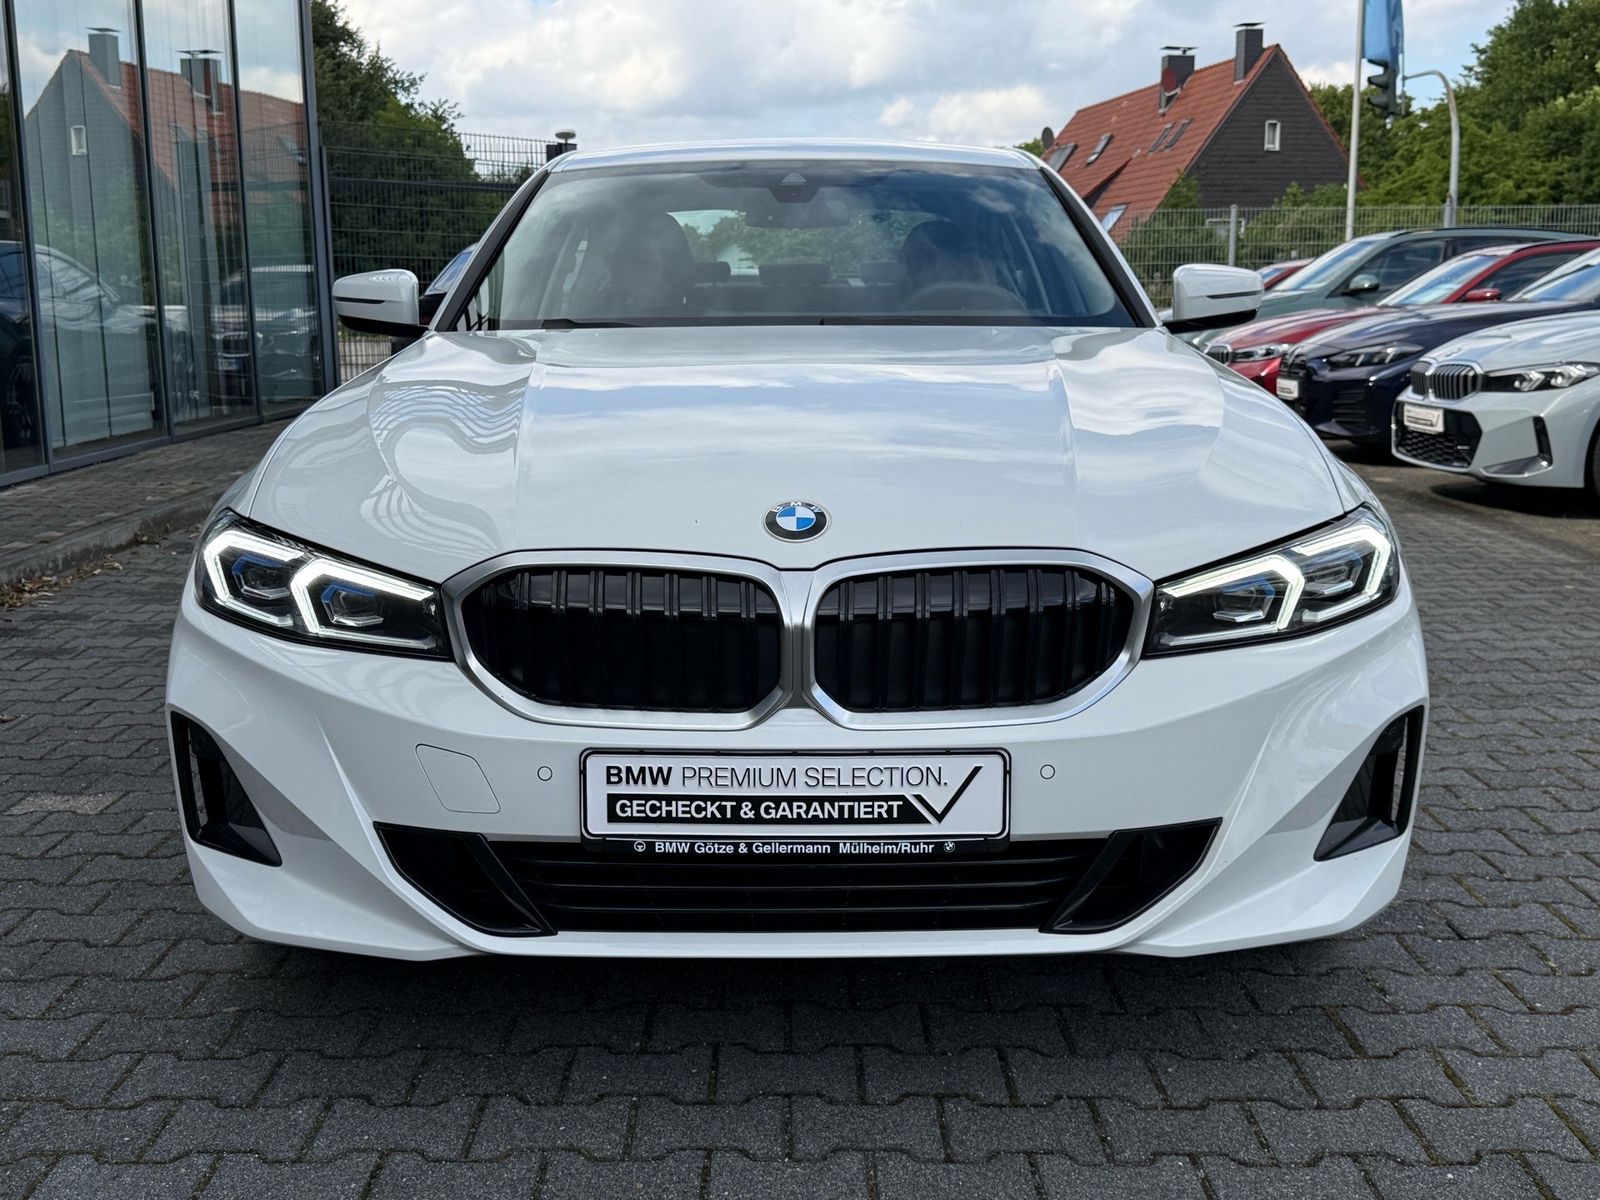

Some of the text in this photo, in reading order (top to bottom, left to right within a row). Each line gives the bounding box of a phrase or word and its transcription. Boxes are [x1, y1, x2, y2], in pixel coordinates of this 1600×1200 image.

[605, 765, 948, 788] BMW PREMIUM SELECTION.
[615, 799, 903, 819] GECHECKT & GARANTIERT
[655, 842, 935, 855] BMW Götze & Gellermann Mülheim/Ruhr
